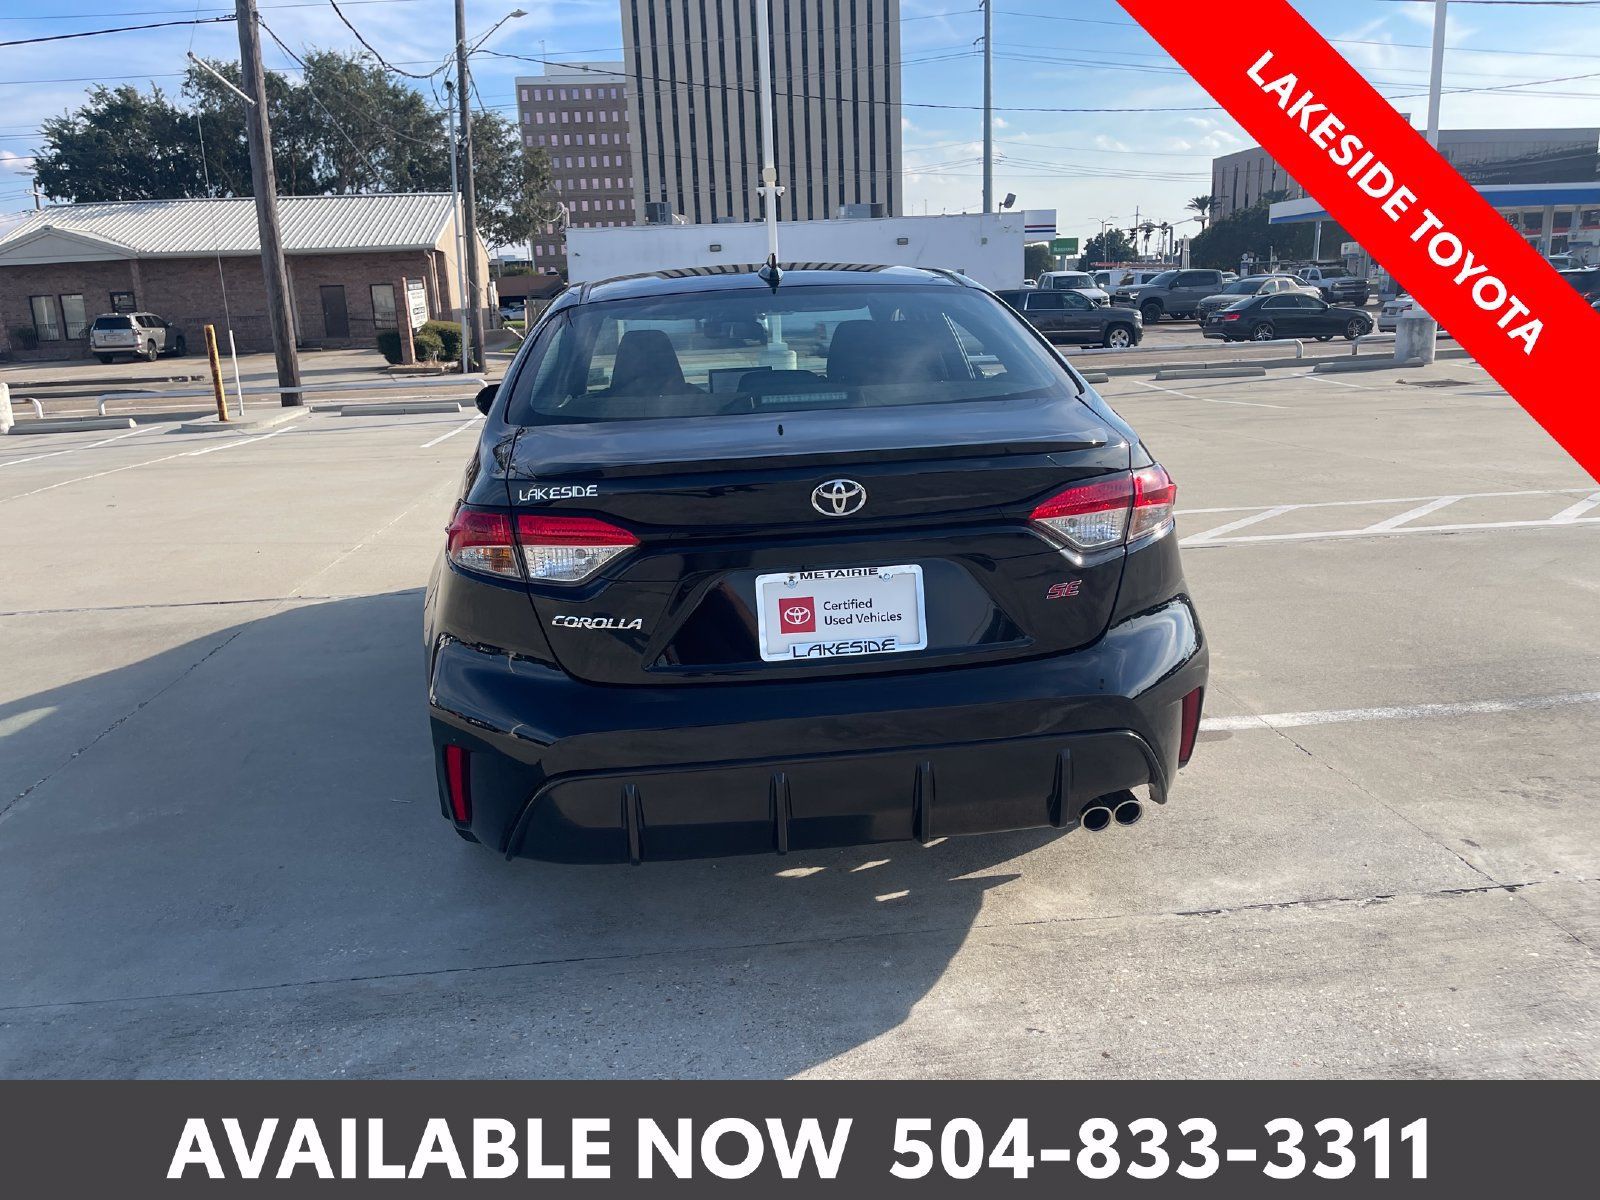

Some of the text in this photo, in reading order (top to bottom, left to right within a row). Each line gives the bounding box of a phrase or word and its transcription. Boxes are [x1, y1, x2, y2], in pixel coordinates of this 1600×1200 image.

[518, 484, 599, 502] LAKESIDE
[800, 567, 879, 580] METAIRIE
[1046, 579, 1082, 600] SE
[823, 598, 873, 611] Certified
[551, 614, 644, 631] COROLLA
[824, 612, 902, 626] Used Vehicles
